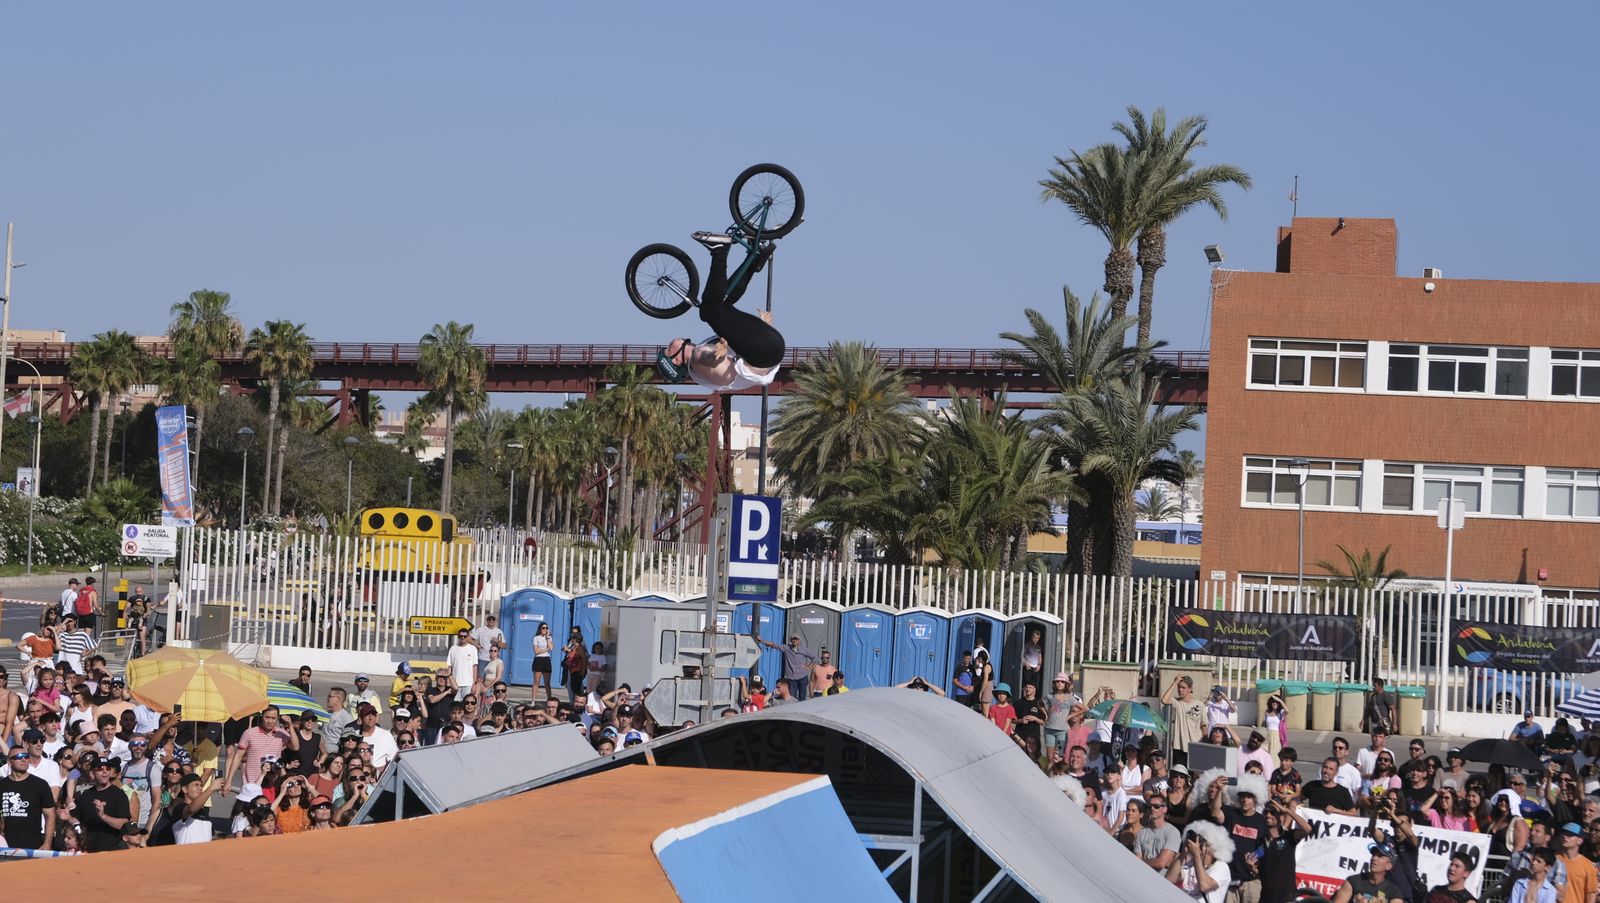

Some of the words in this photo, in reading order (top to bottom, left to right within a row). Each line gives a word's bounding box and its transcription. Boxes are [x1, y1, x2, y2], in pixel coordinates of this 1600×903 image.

[739, 499, 770, 559] P
[742, 584, 757, 592] LIBRE
[1303, 818, 1335, 842] MX
[1339, 856, 1358, 872] EN
